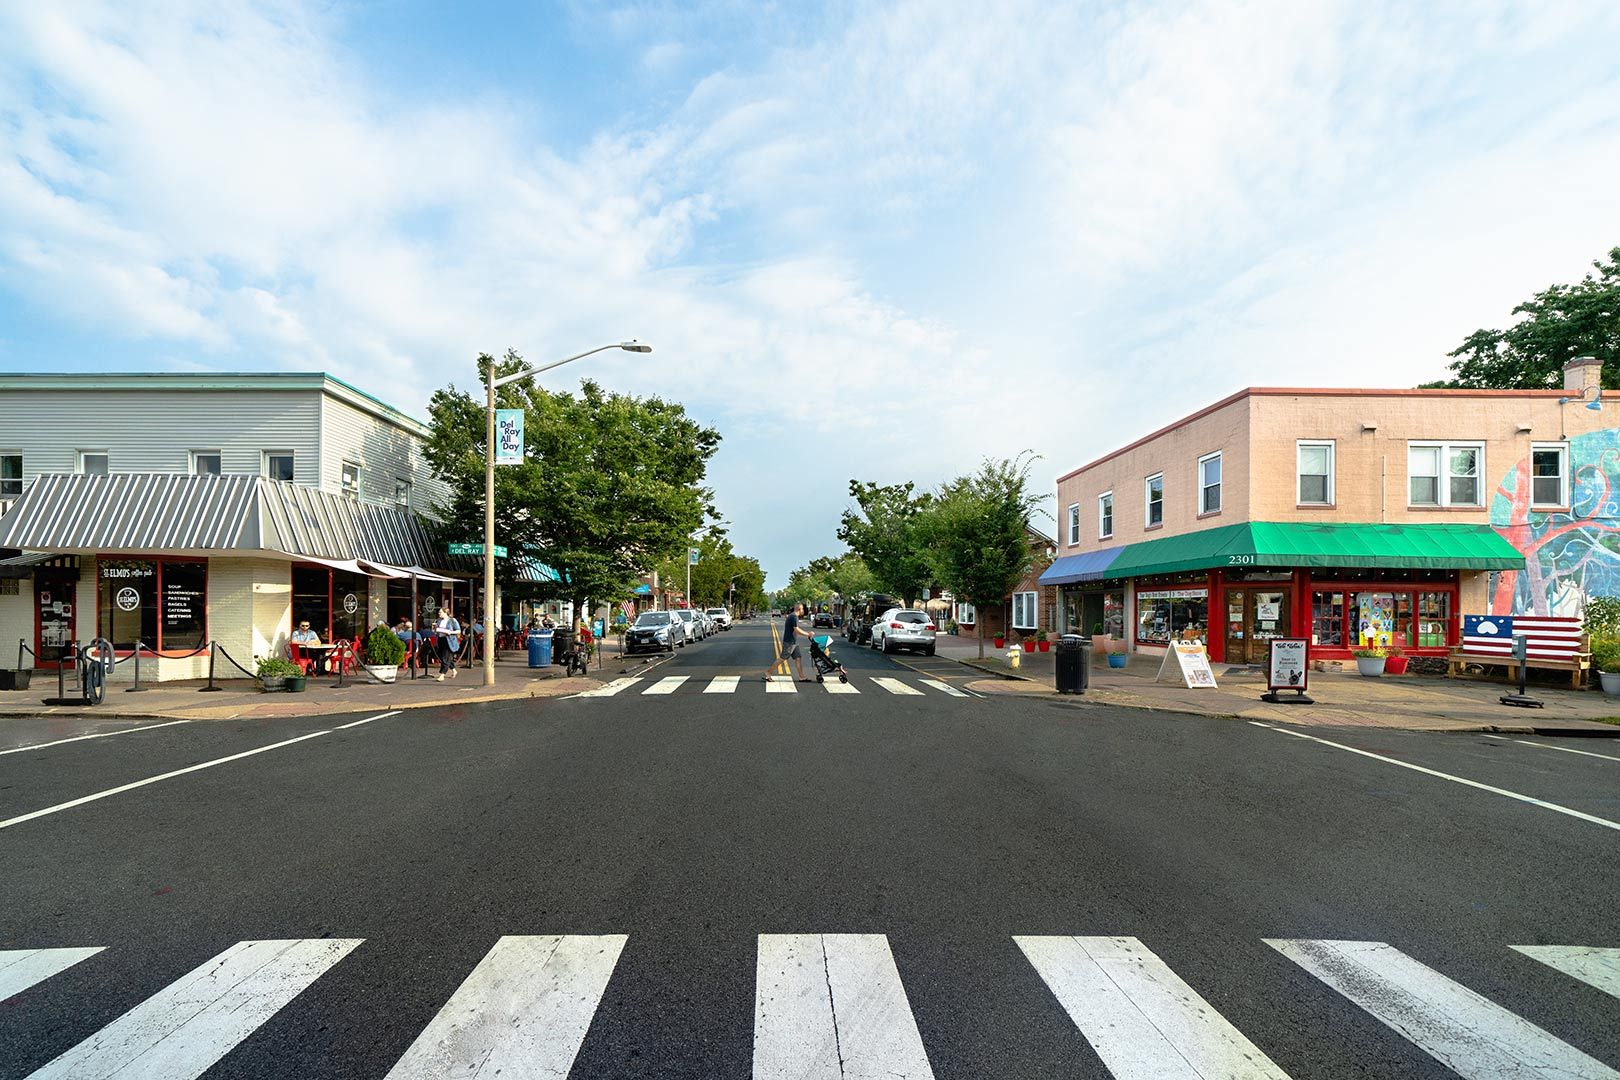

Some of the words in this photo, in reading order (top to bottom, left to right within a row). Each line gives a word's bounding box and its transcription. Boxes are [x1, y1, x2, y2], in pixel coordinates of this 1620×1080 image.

[501, 420, 513, 428] Del
[504, 428, 520, 437] Ray
[500, 435, 511, 443] All
[502, 442, 520, 452] Day
[1229, 555, 1254, 564] 2301
